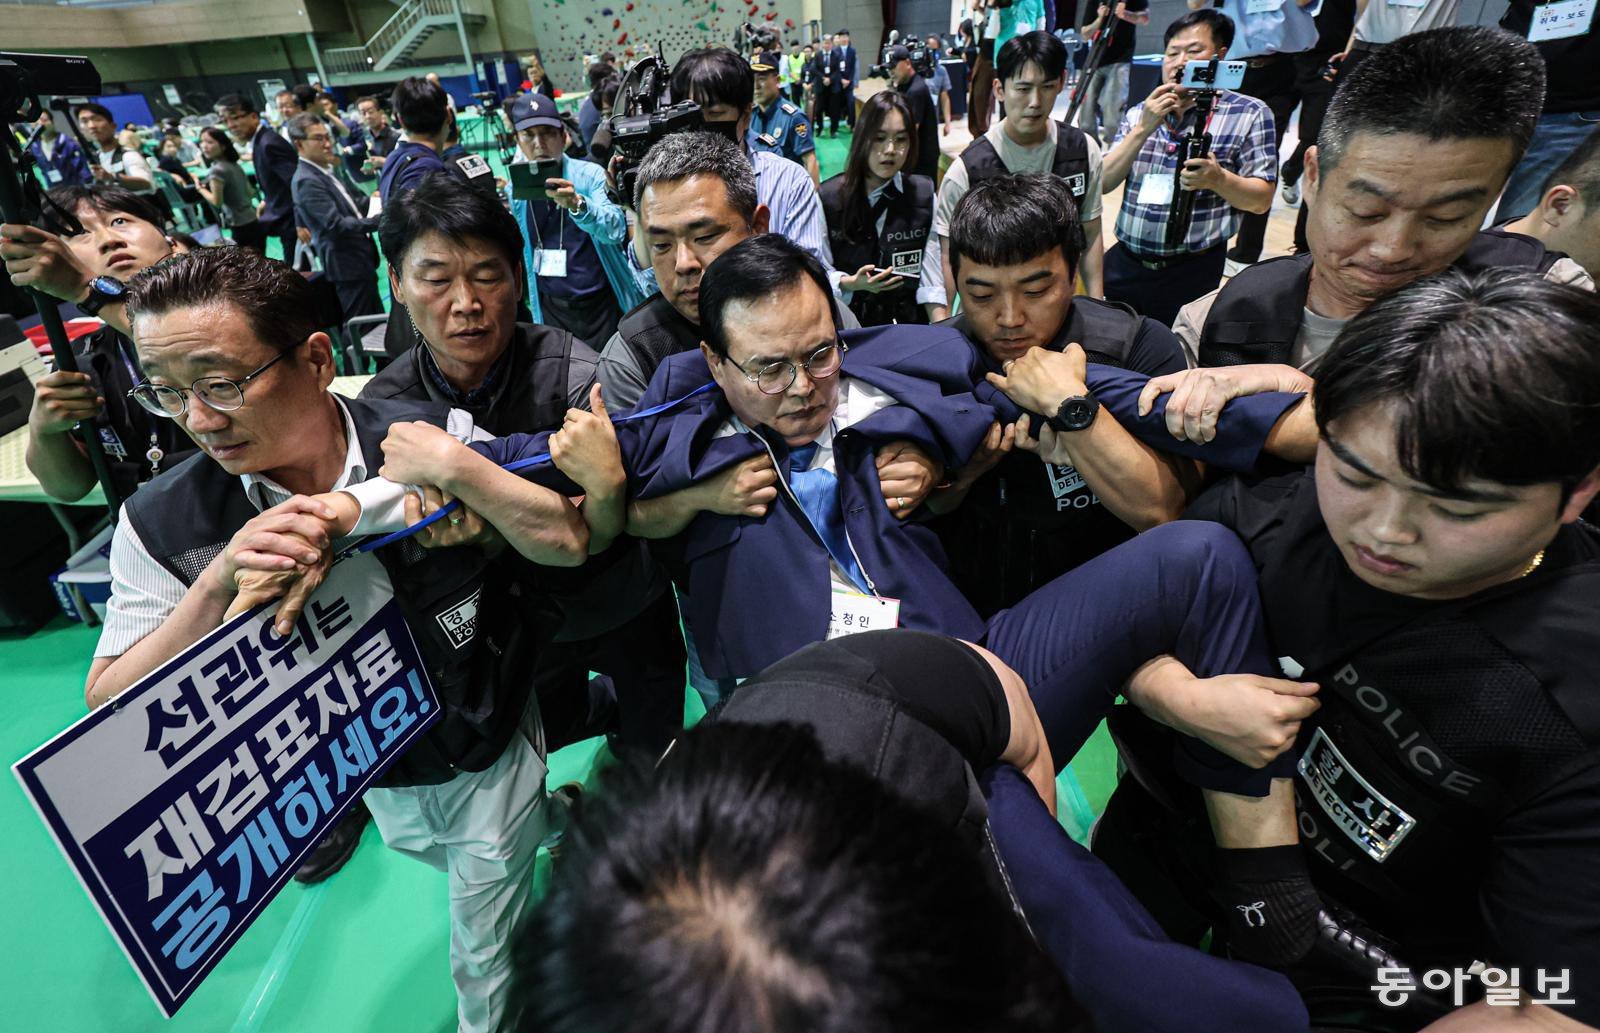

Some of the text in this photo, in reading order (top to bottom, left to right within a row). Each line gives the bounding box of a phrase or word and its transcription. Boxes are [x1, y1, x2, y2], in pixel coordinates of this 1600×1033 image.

[887, 228, 927, 242] POLICE
[144, 596, 351, 770] 선관위는
[1333, 664, 1482, 795] POLICE
[124, 628, 404, 902] 재검표자료
[151, 668, 432, 971] 공개하세요!
[1306, 766, 1386, 852] DETECTIVE
